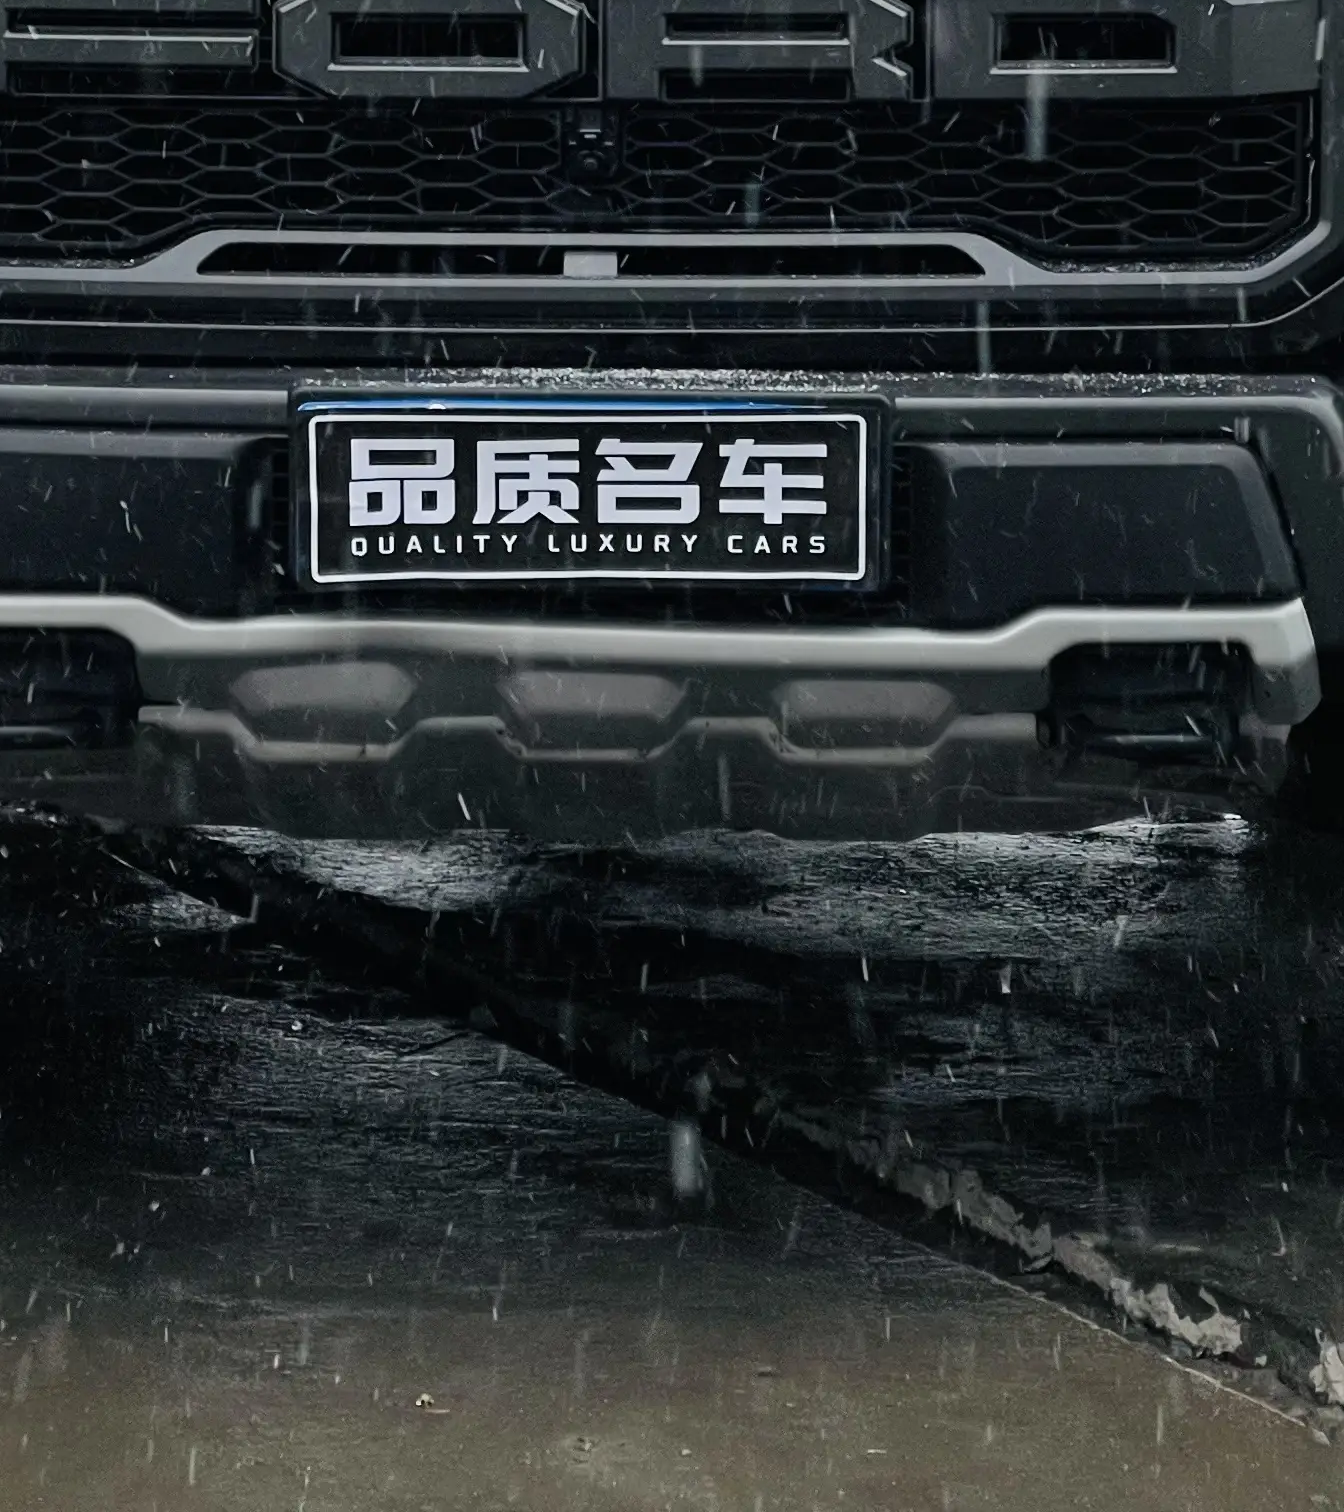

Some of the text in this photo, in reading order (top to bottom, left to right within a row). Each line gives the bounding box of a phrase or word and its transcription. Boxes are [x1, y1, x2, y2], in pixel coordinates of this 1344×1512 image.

[348, 437, 829, 525] 品质名车
[350, 533, 827, 557] QUALITY LUXURY CARS
